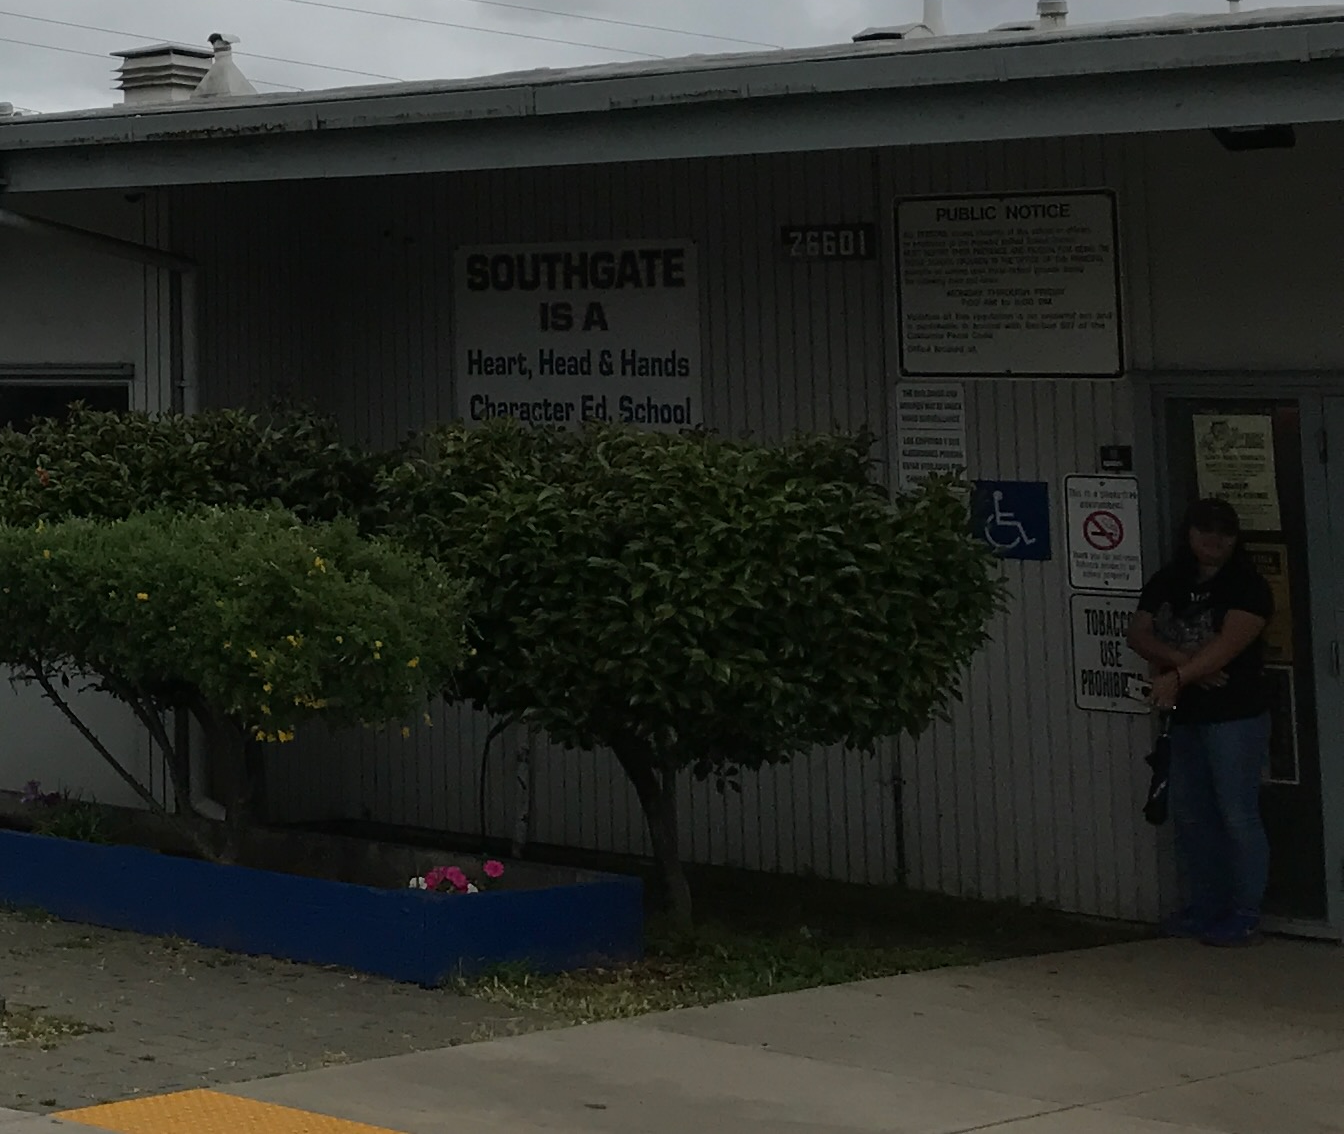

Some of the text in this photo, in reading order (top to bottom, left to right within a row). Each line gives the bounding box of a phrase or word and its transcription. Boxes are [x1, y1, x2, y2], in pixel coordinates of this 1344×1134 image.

[937, 203, 1071, 222] PUBLIC NOTICE
[789, 229, 866, 257] 26601
[466, 249, 686, 291] SOUTHGATE
[540, 302, 608, 332] IS A
[467, 349, 690, 379] Heart, Head & Hands
[470, 394, 574, 421] Character
[619, 395, 692, 424] School
[1100, 640, 1122, 667] USE
